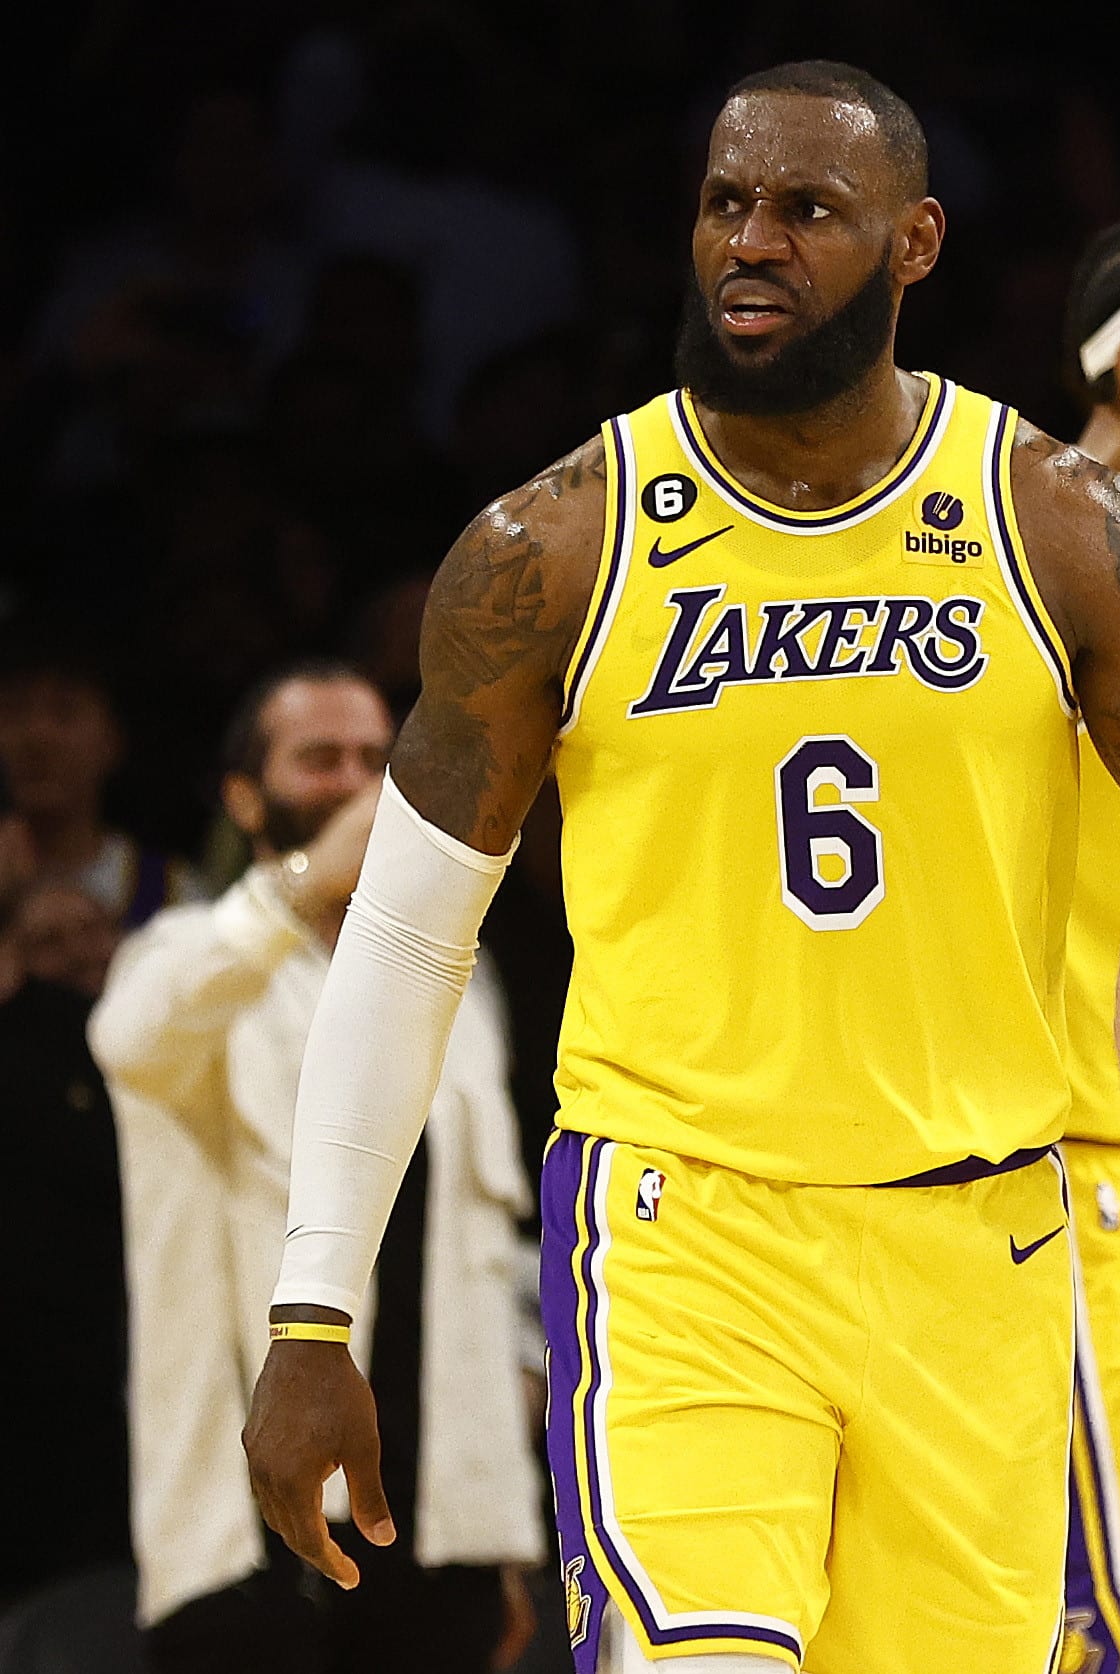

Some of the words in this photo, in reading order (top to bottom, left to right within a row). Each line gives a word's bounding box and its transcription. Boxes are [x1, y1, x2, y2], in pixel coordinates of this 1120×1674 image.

[654, 479, 684, 517] 6
[905, 530, 983, 564] bibigo
[626, 583, 990, 720] LAKERS
[774, 734, 887, 932] 6
